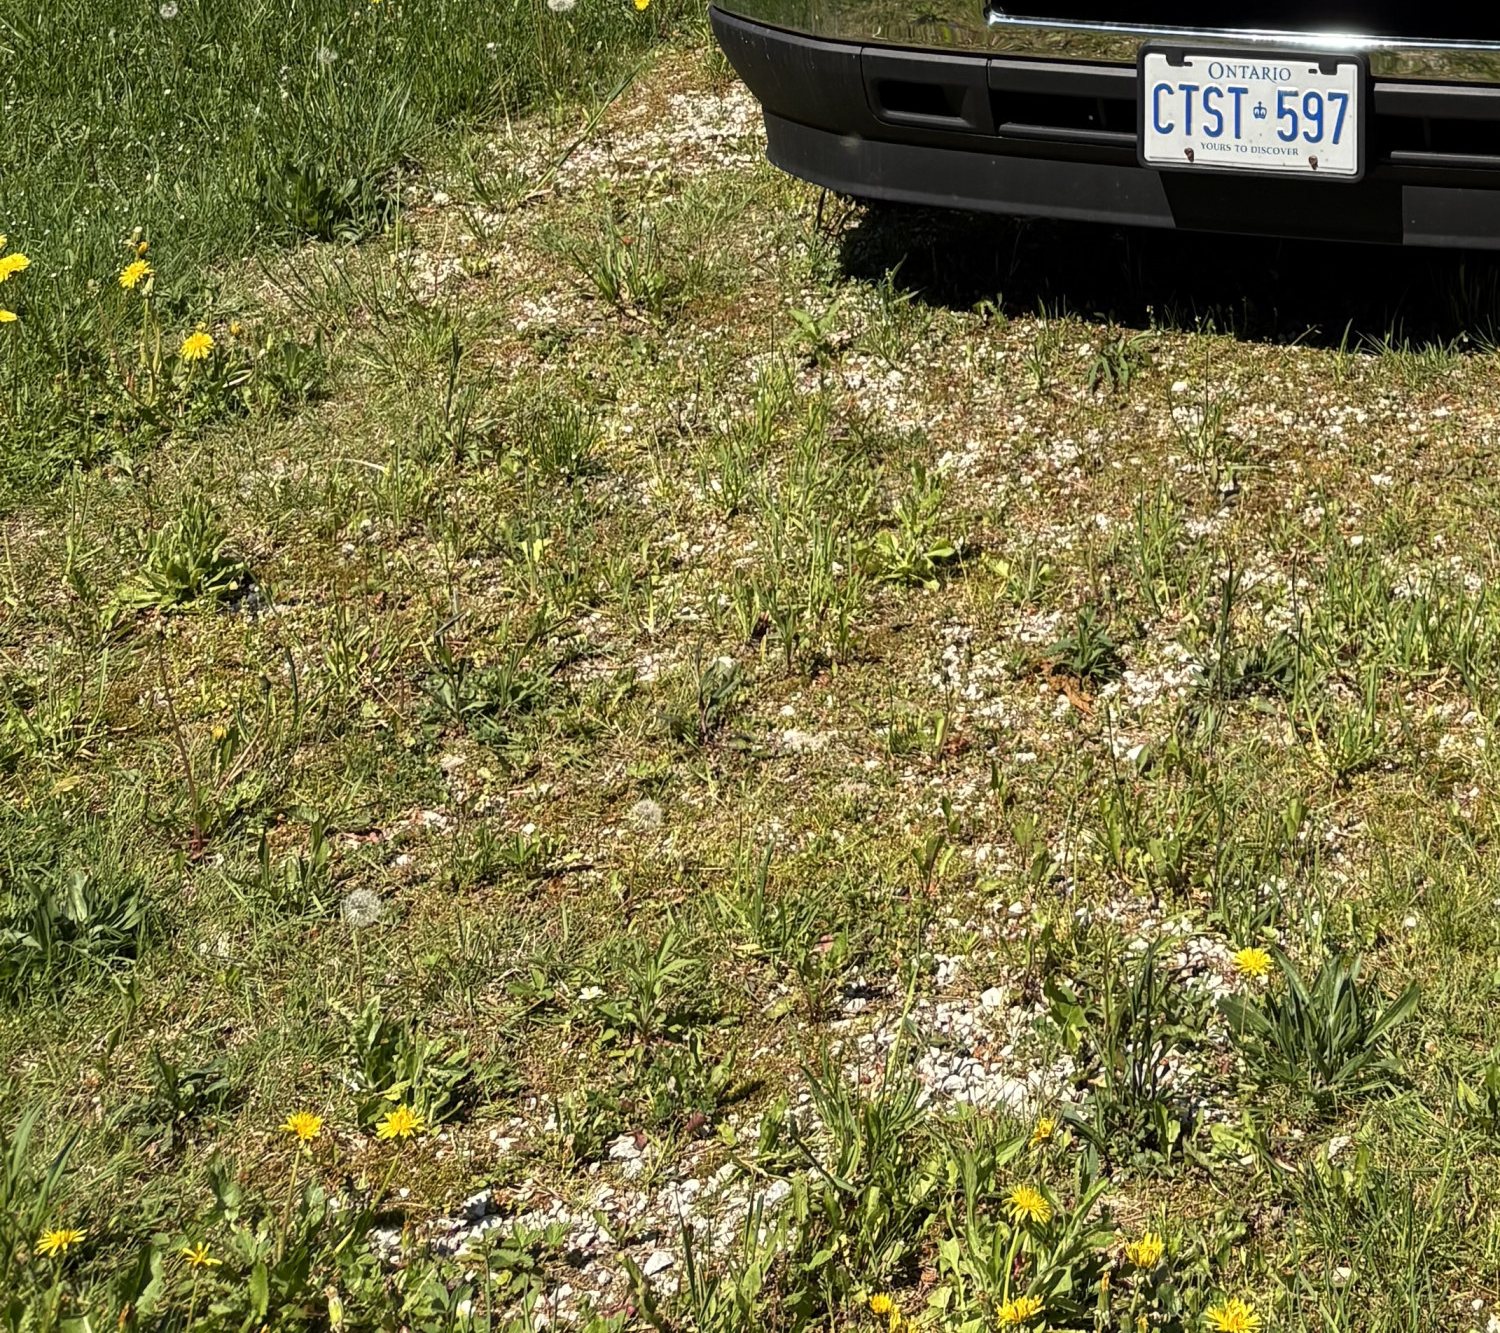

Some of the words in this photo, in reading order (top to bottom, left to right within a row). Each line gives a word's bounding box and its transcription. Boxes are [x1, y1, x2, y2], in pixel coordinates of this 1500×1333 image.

[1208, 61, 1292, 83] ONTARIO
[1153, 83, 1249, 140] CTST
[1276, 89, 1349, 145] 597
[1200, 142, 1231, 152] YOURS
[1234, 144, 1248, 153] TO
[1250, 146, 1299, 156] DISCOVER
